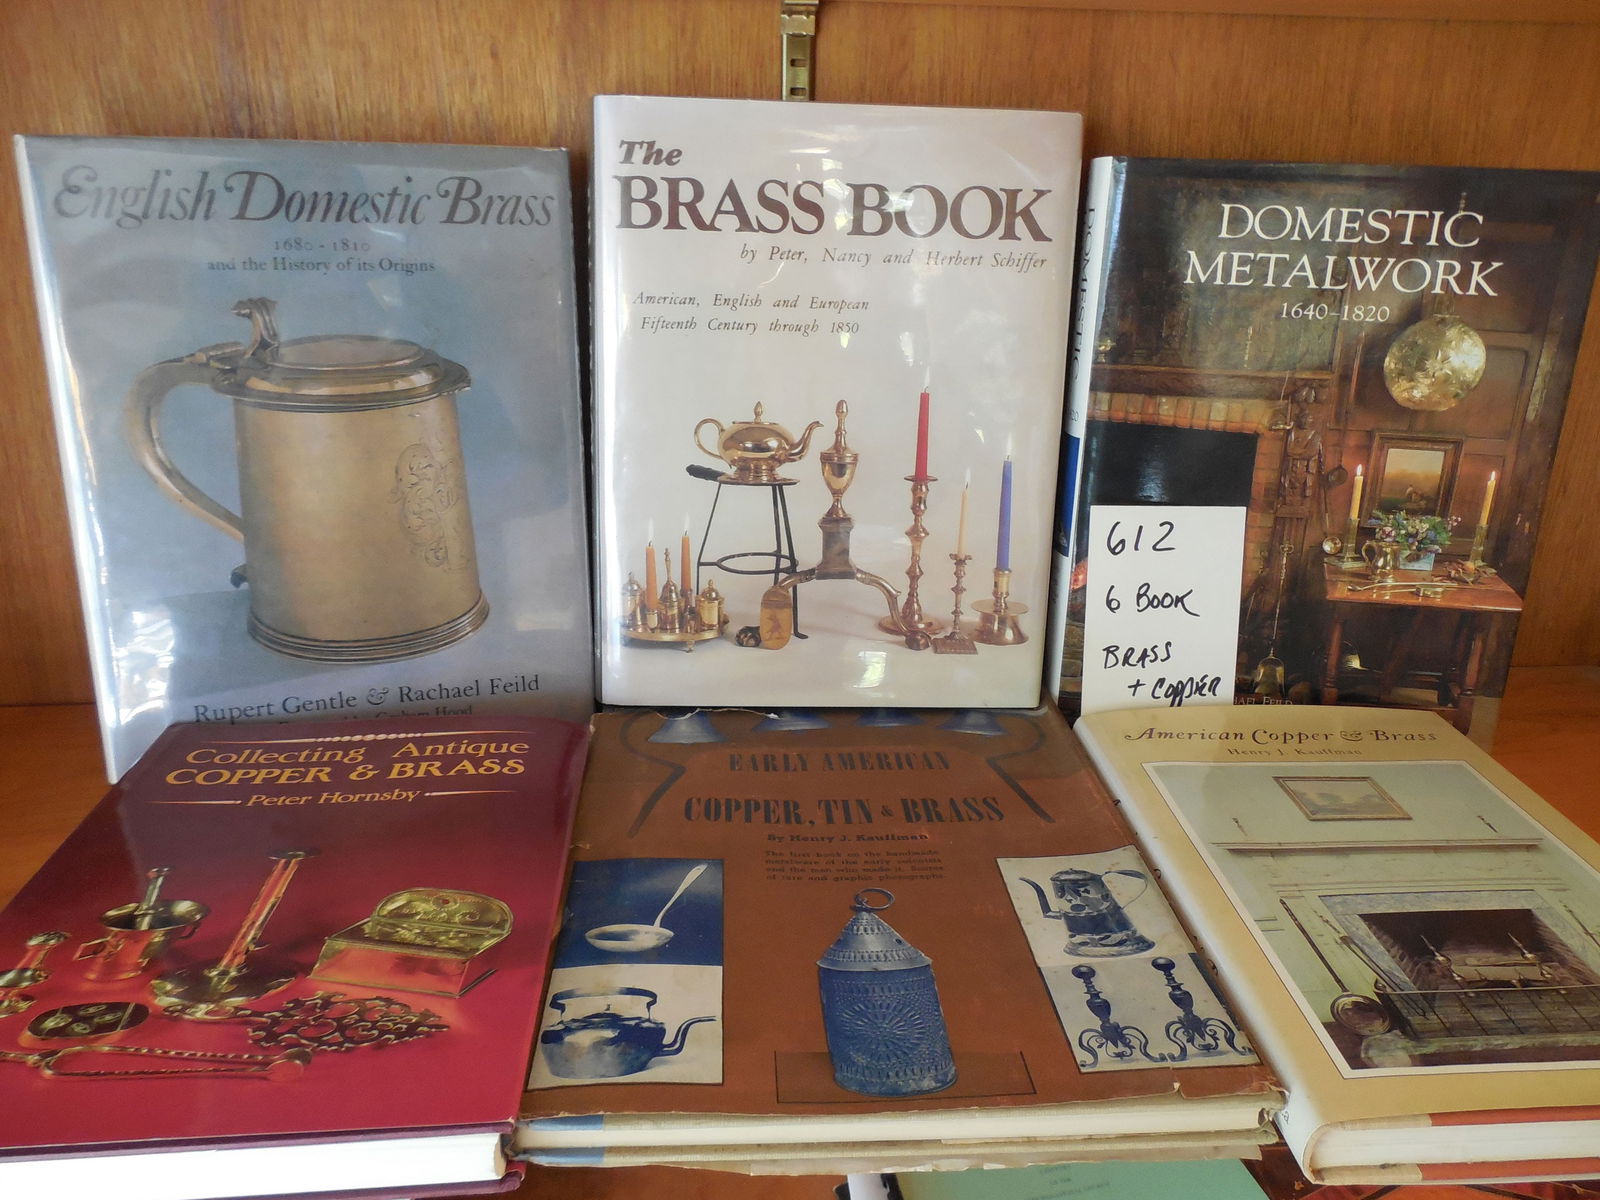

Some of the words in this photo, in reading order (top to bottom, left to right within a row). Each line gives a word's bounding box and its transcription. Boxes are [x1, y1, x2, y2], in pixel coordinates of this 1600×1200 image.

[618, 139, 683, 167] The
[54, 164, 217, 230] English
[223, 170, 430, 226] Domestic
[435, 175, 558, 227] Brass
[612, 175, 825, 236] BRASS
[846, 182, 1053, 242] BOOK
[1217, 203, 1485, 248] DOMESTIC
[242, 257, 268, 272] the
[273, 257, 331, 276] History
[336, 257, 353, 272] of
[357, 259, 375, 272] its
[378, 258, 436, 277] Origins
[740, 246, 757, 264] by
[768, 246, 809, 264] Peter,
[822, 248, 872, 267] Nancy
[882, 250, 913, 266] and
[925, 251, 985, 268] Herbert
[990, 253, 1049, 274] Schiffer
[1183, 250, 1505, 298] METALWORK
[633, 292, 702, 309] American,
[713, 293, 763, 311] English
[773, 295, 799, 309] and
[809, 296, 870, 312] European
[641, 316, 698, 333] Fifteenth
[707, 318, 759, 335] Century
[769, 319, 820, 336] through
[831, 320, 860, 336] 1850
[1106, 520, 1177, 556] 612
[1105, 584, 1121, 614] 6
[194, 700, 275, 725] Rupert
[282, 691, 357, 716] Gentle
[399, 680, 481, 703] Rachael
[489, 674, 541, 696] Feild
[1124, 726, 1245, 742] American
[1251, 728, 1334, 746] Copper
[1371, 729, 1438, 744] Brass
[185, 746, 367, 766] Collecting
[392, 739, 531, 761] Antique
[730, 752, 809, 773] EARLY
[821, 751, 951, 773] AMERICAN
[164, 767, 332, 788] COPPER
[348, 764, 376, 783] &
[384, 758, 527, 782] BRASS
[245, 794, 312, 807] Peter
[318, 789, 421, 806] Hornsby
[684, 796, 814, 828] COPPER,
[817, 798, 874, 827] TIN
[901, 797, 1006, 826] BRASS
